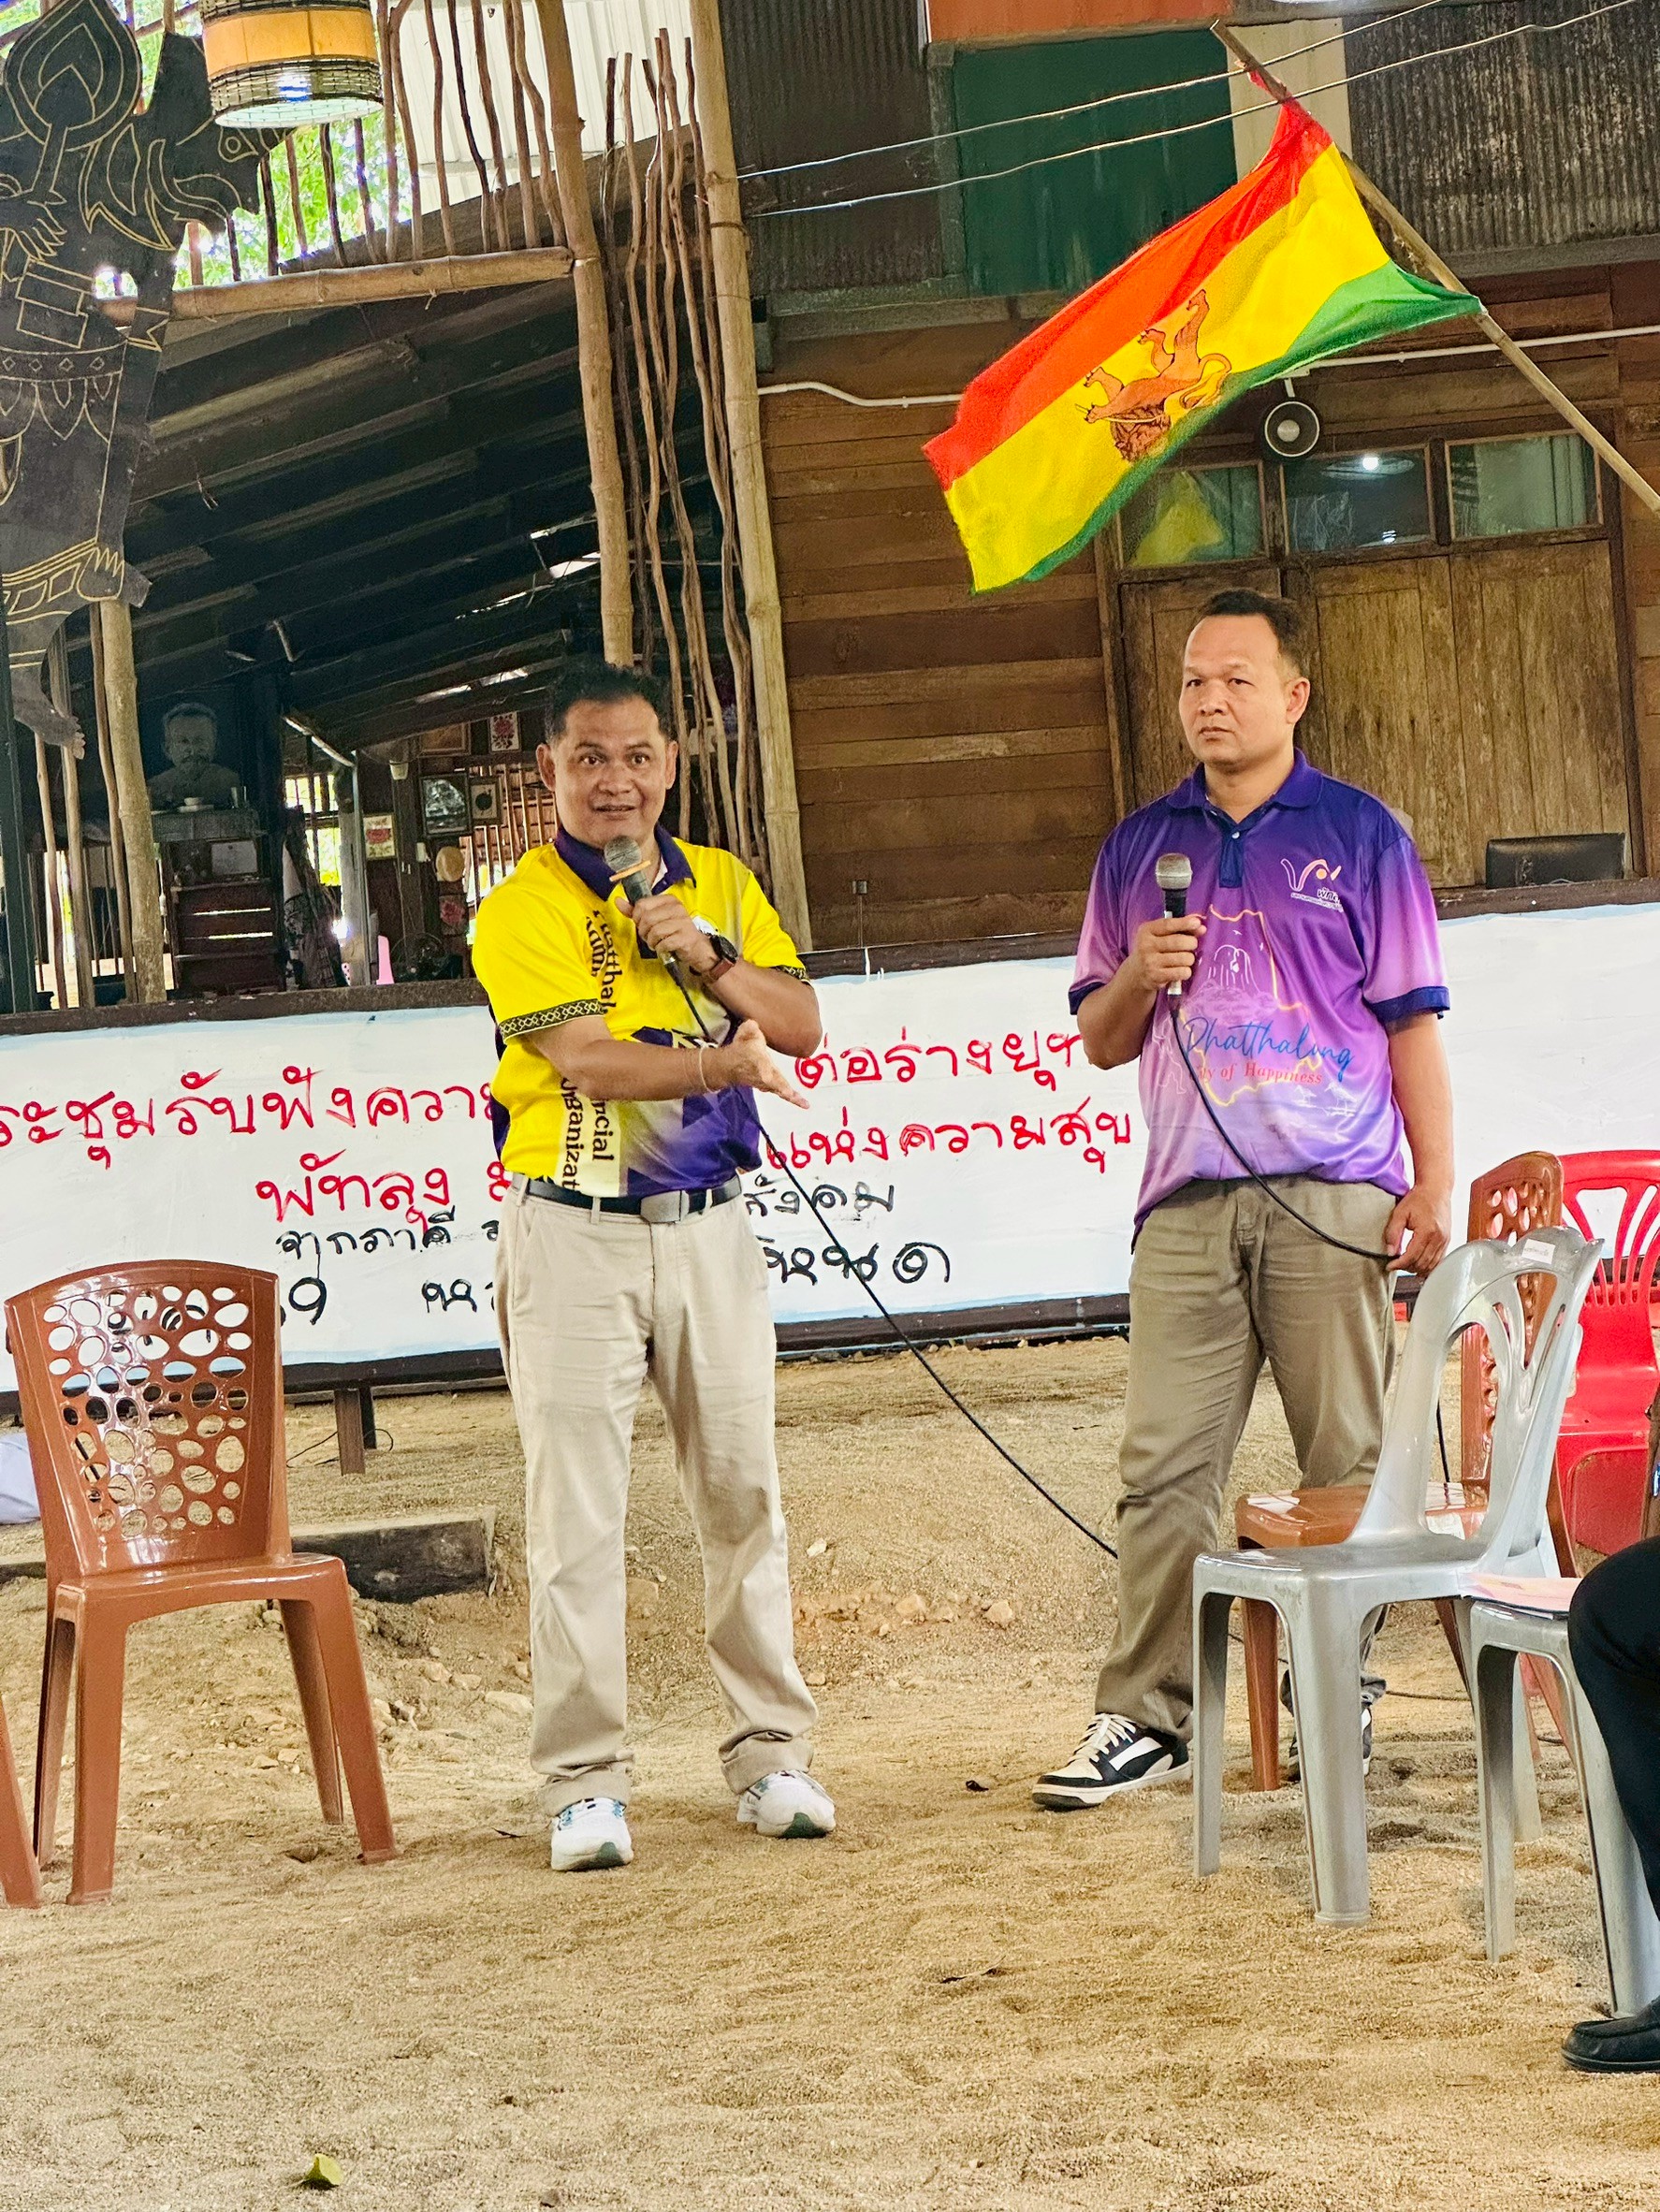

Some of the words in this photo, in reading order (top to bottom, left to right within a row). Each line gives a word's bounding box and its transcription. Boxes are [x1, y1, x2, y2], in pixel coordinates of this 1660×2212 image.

[1183, 1017, 1355, 1082] Phatthalung
[1220, 1063, 1238, 1082] of
[1244, 1060, 1322, 1084] Happiness
[591, 1099, 615, 1161] ncial
[255, 1149, 450, 1234] พัทลุง
